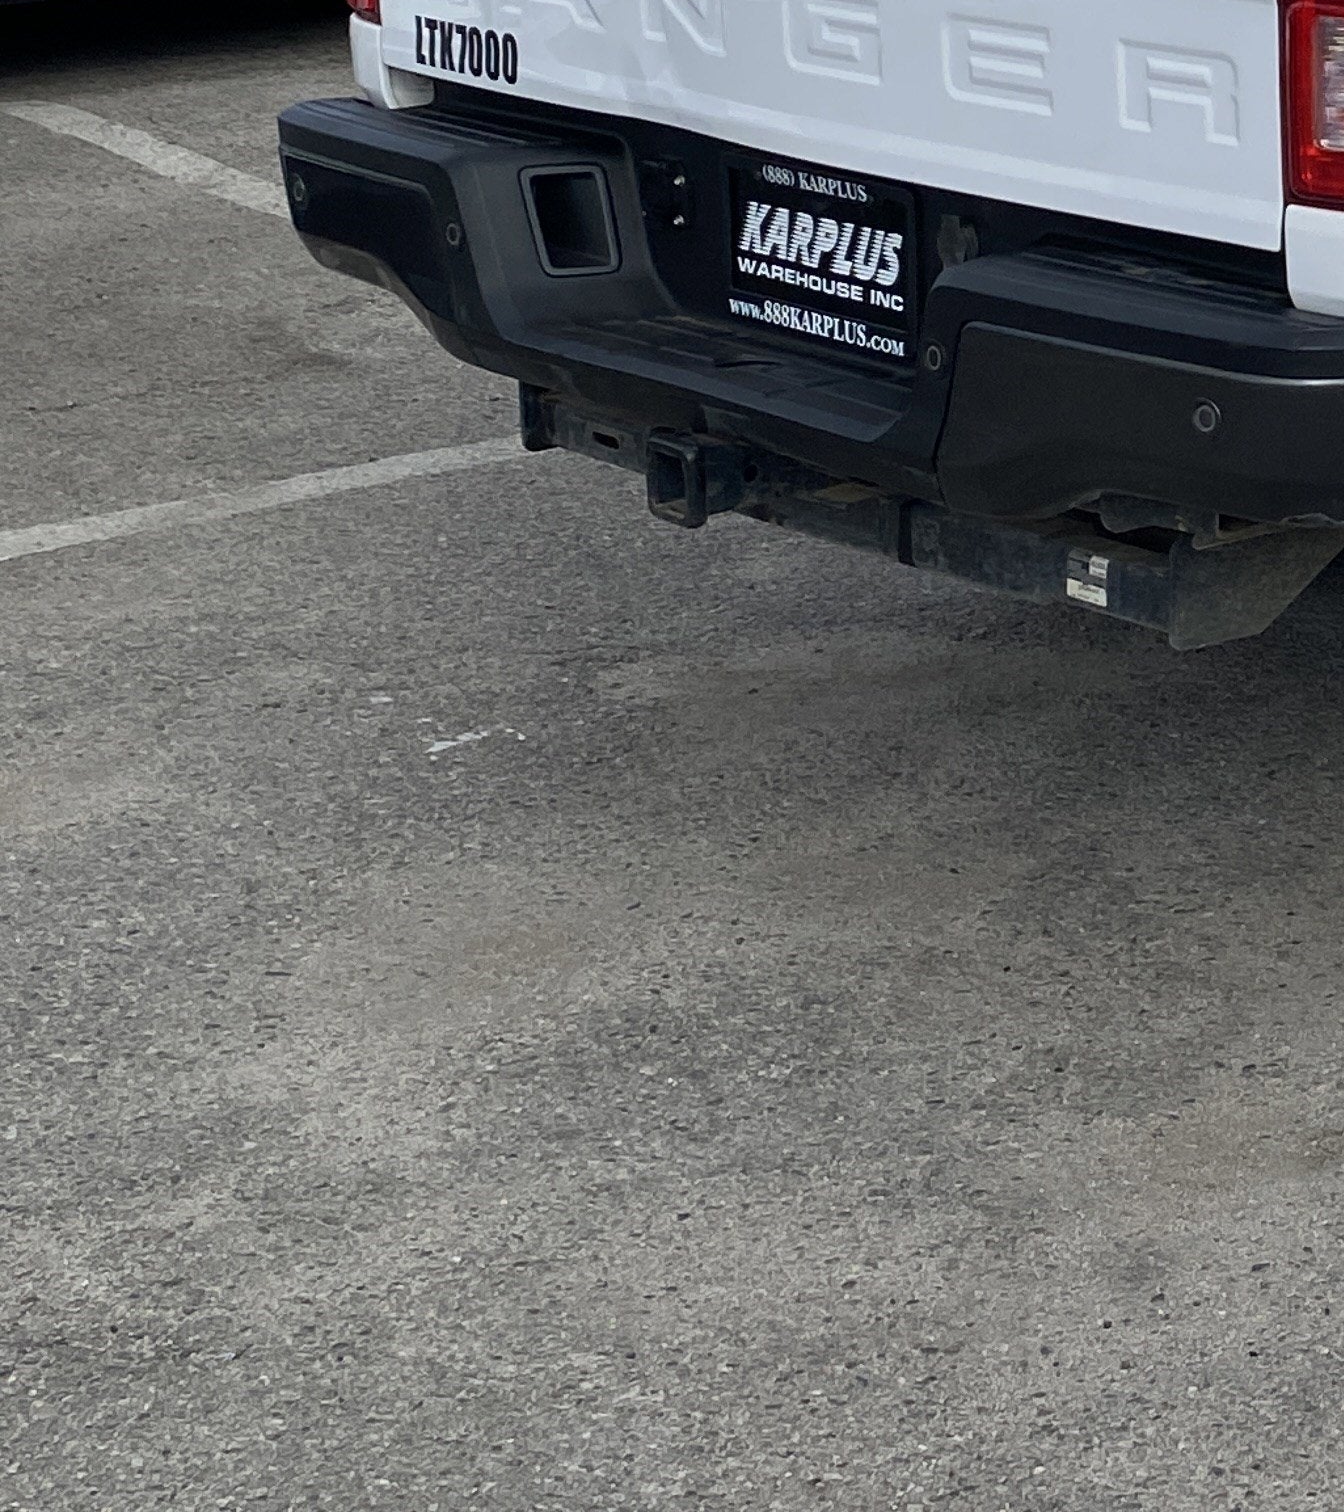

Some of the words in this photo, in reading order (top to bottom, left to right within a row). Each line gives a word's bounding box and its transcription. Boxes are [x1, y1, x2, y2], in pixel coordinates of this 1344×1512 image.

[414, 15, 519, 85] LTK7000
[762, 164, 795, 187] (888)
[797, 171, 868, 203] KARPLUS
[737, 201, 904, 287] KARPLUS
[736, 256, 864, 303] WAREHOUSE
[869, 289, 905, 312] INC
